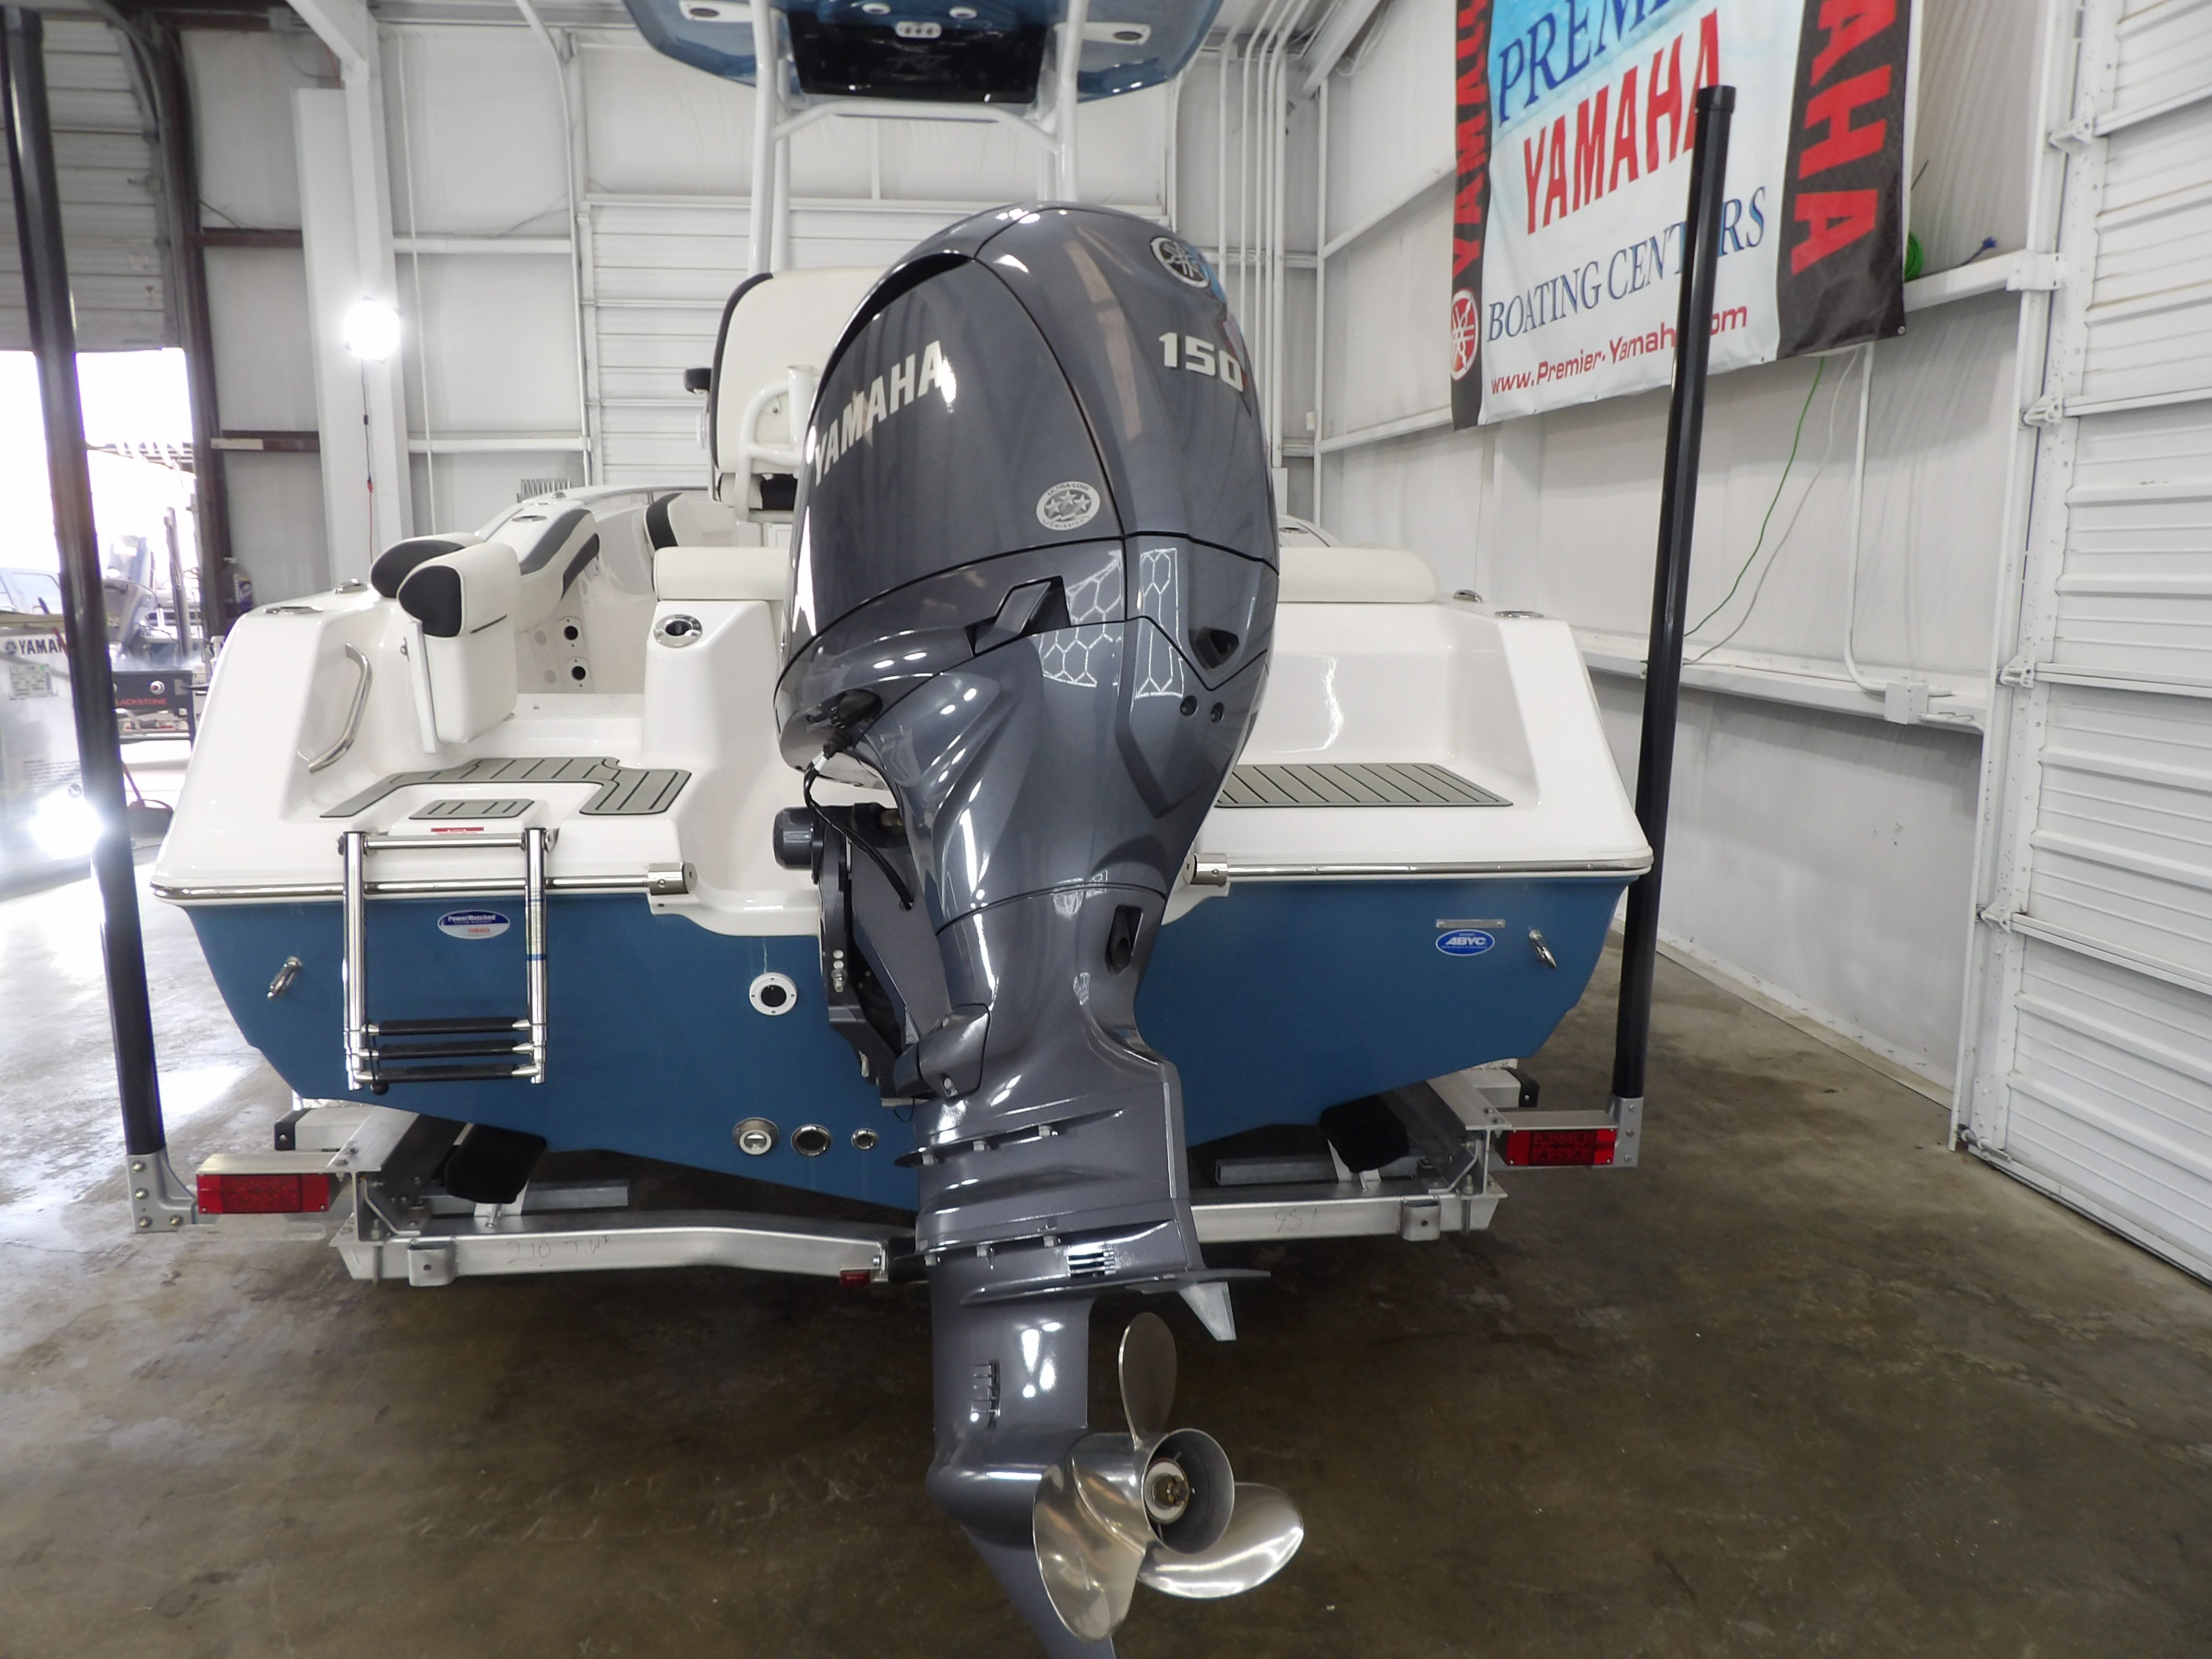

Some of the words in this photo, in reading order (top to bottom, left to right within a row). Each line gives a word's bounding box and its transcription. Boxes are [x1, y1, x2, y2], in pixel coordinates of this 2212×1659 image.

[1488, 261, 1602, 342] BOATING
[1607, 186, 1766, 300] CENTRS
[1159, 332, 1243, 392] 150
[1491, 305, 1747, 395] www.Premier-Yamahom
[815, 340, 944, 487] YAMAHA
[18, 639, 68, 654] YAMA
[1444, 937, 1487, 945] ABYC
